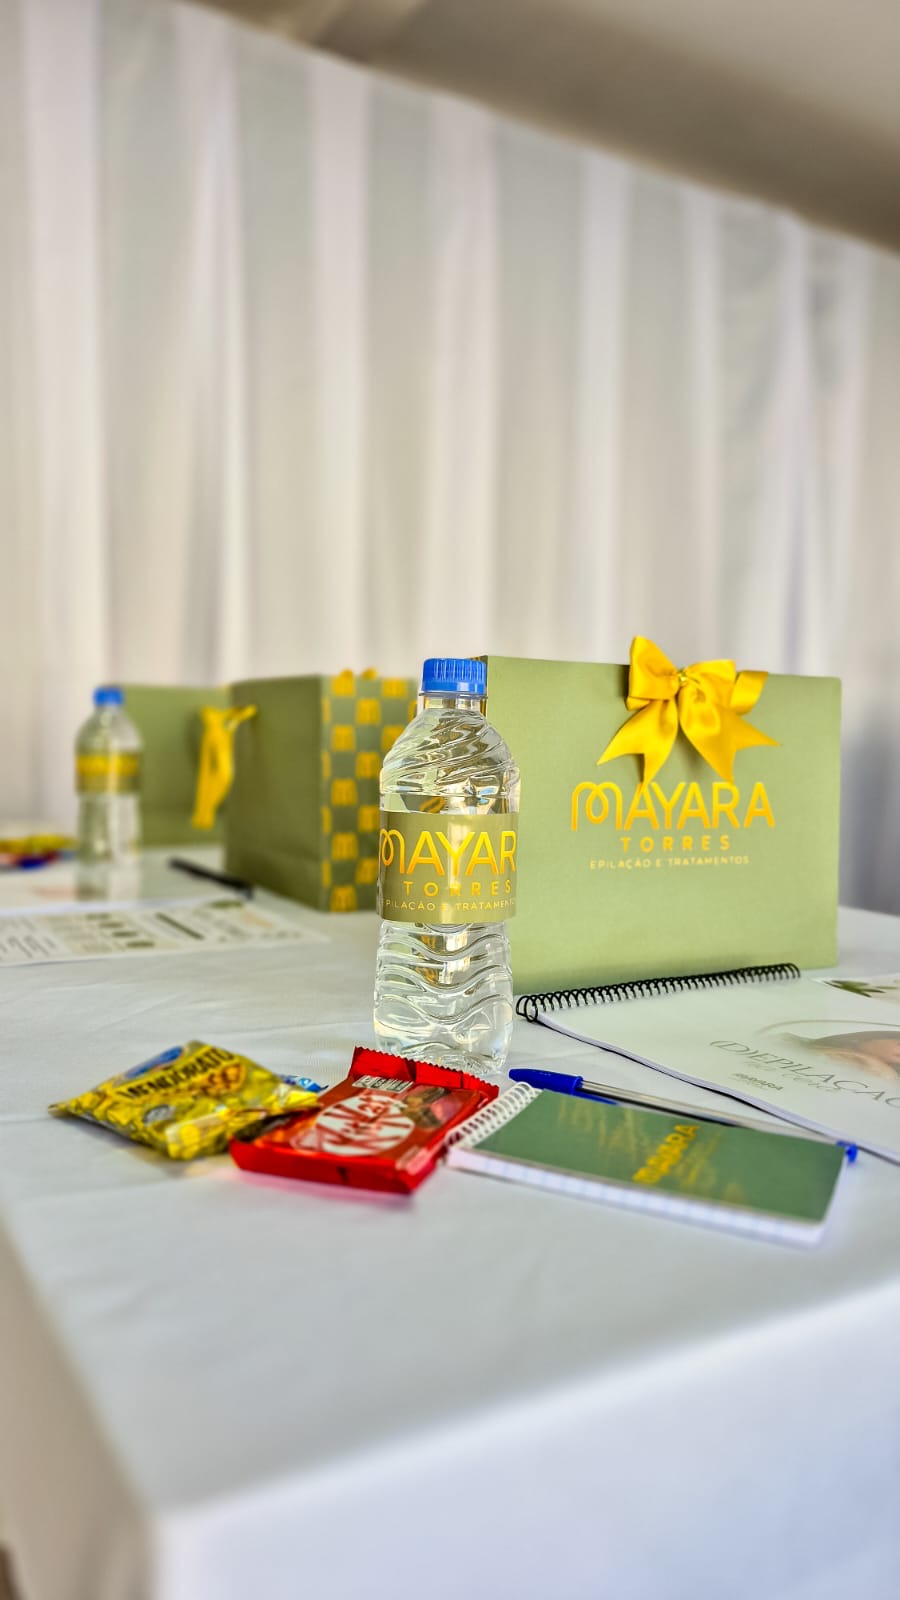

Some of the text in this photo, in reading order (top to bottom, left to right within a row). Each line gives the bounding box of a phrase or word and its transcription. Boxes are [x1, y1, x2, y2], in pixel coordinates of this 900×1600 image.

[571, 781, 775, 831] MAYARA
[620, 835, 730, 853] TORRES
[655, 858, 662, 868] E
[667, 855, 750, 867] TRATAMENTOS
[403, 879, 512, 897] TORRES
